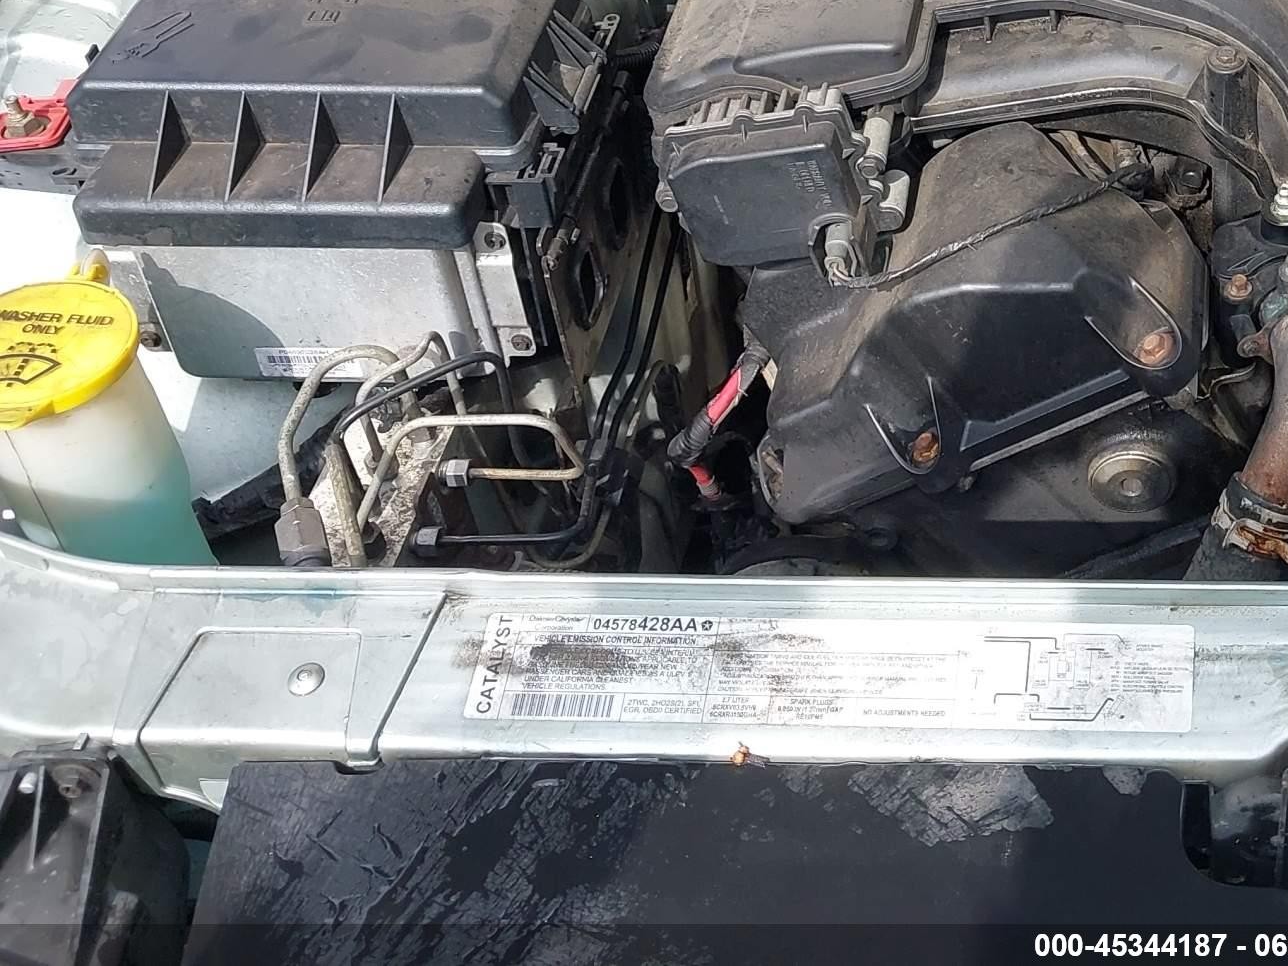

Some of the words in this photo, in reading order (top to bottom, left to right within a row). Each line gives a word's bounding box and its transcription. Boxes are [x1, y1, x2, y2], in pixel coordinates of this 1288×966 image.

[66, 314, 114, 326] FLUID
[22, 323, 65, 334] ONLY
[593, 617, 697, 632] 04578428AA
[606, 636, 642, 644] CONTROL
[644, 637, 697, 645] INFORMATION
[476, 615, 513, 714] CATALYST
